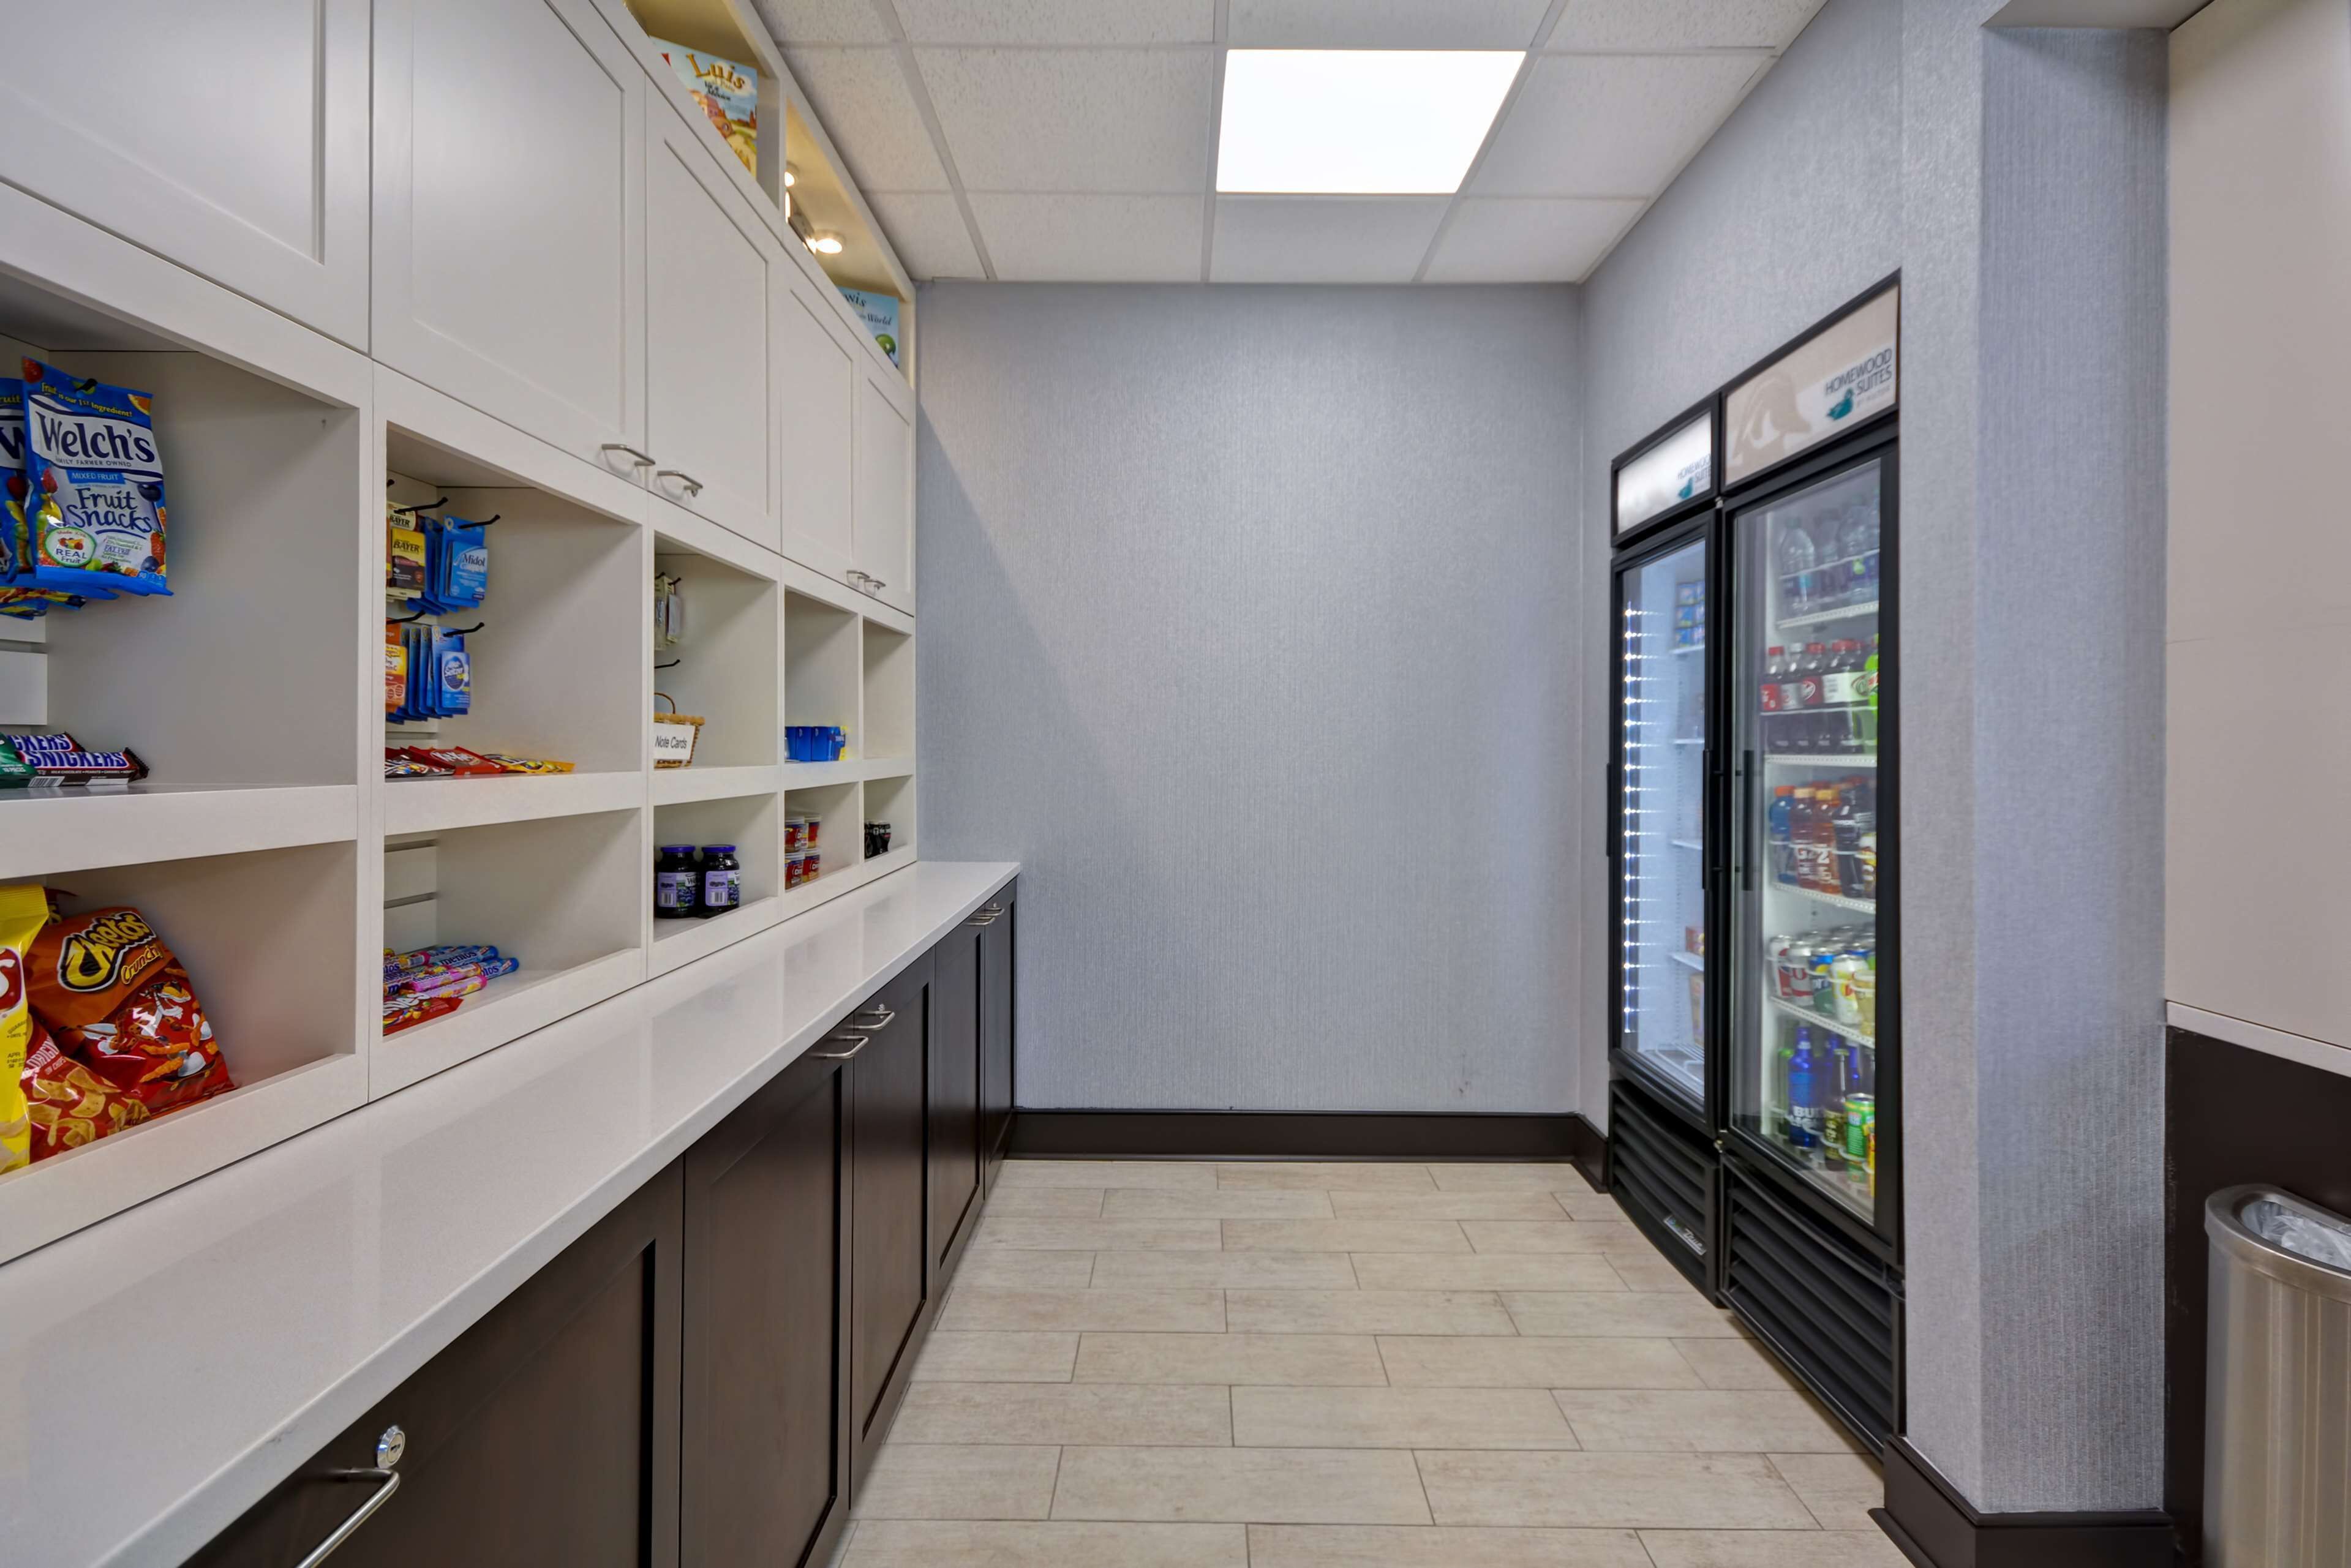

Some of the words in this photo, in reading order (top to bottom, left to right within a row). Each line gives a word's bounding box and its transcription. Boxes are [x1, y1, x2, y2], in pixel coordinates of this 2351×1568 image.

[686, 53, 745, 89] Luis
[867, 313, 892, 326] World
[1825, 348, 1893, 396] HOMEWOOD
[1856, 364, 1892, 396] SUITES
[91, 401, 133, 418] Ingredient!
[35, 411, 156, 463] Welch's
[74, 487, 138, 511] Fruit
[66, 503, 154, 533] Snacks
[389, 514, 410, 527] BAYER
[56, 548, 87, 560] REAL
[393, 539, 421, 553] BAYER
[61, 555, 81, 564] Fruit
[462, 551, 486, 567] Midol
[655, 735, 669, 748] Note
[670, 736, 687, 749] Cards
[28, 751, 129, 768] SNICKERS
[64, 912, 152, 987] Cheetos
[440, 951, 478, 966] mentos
